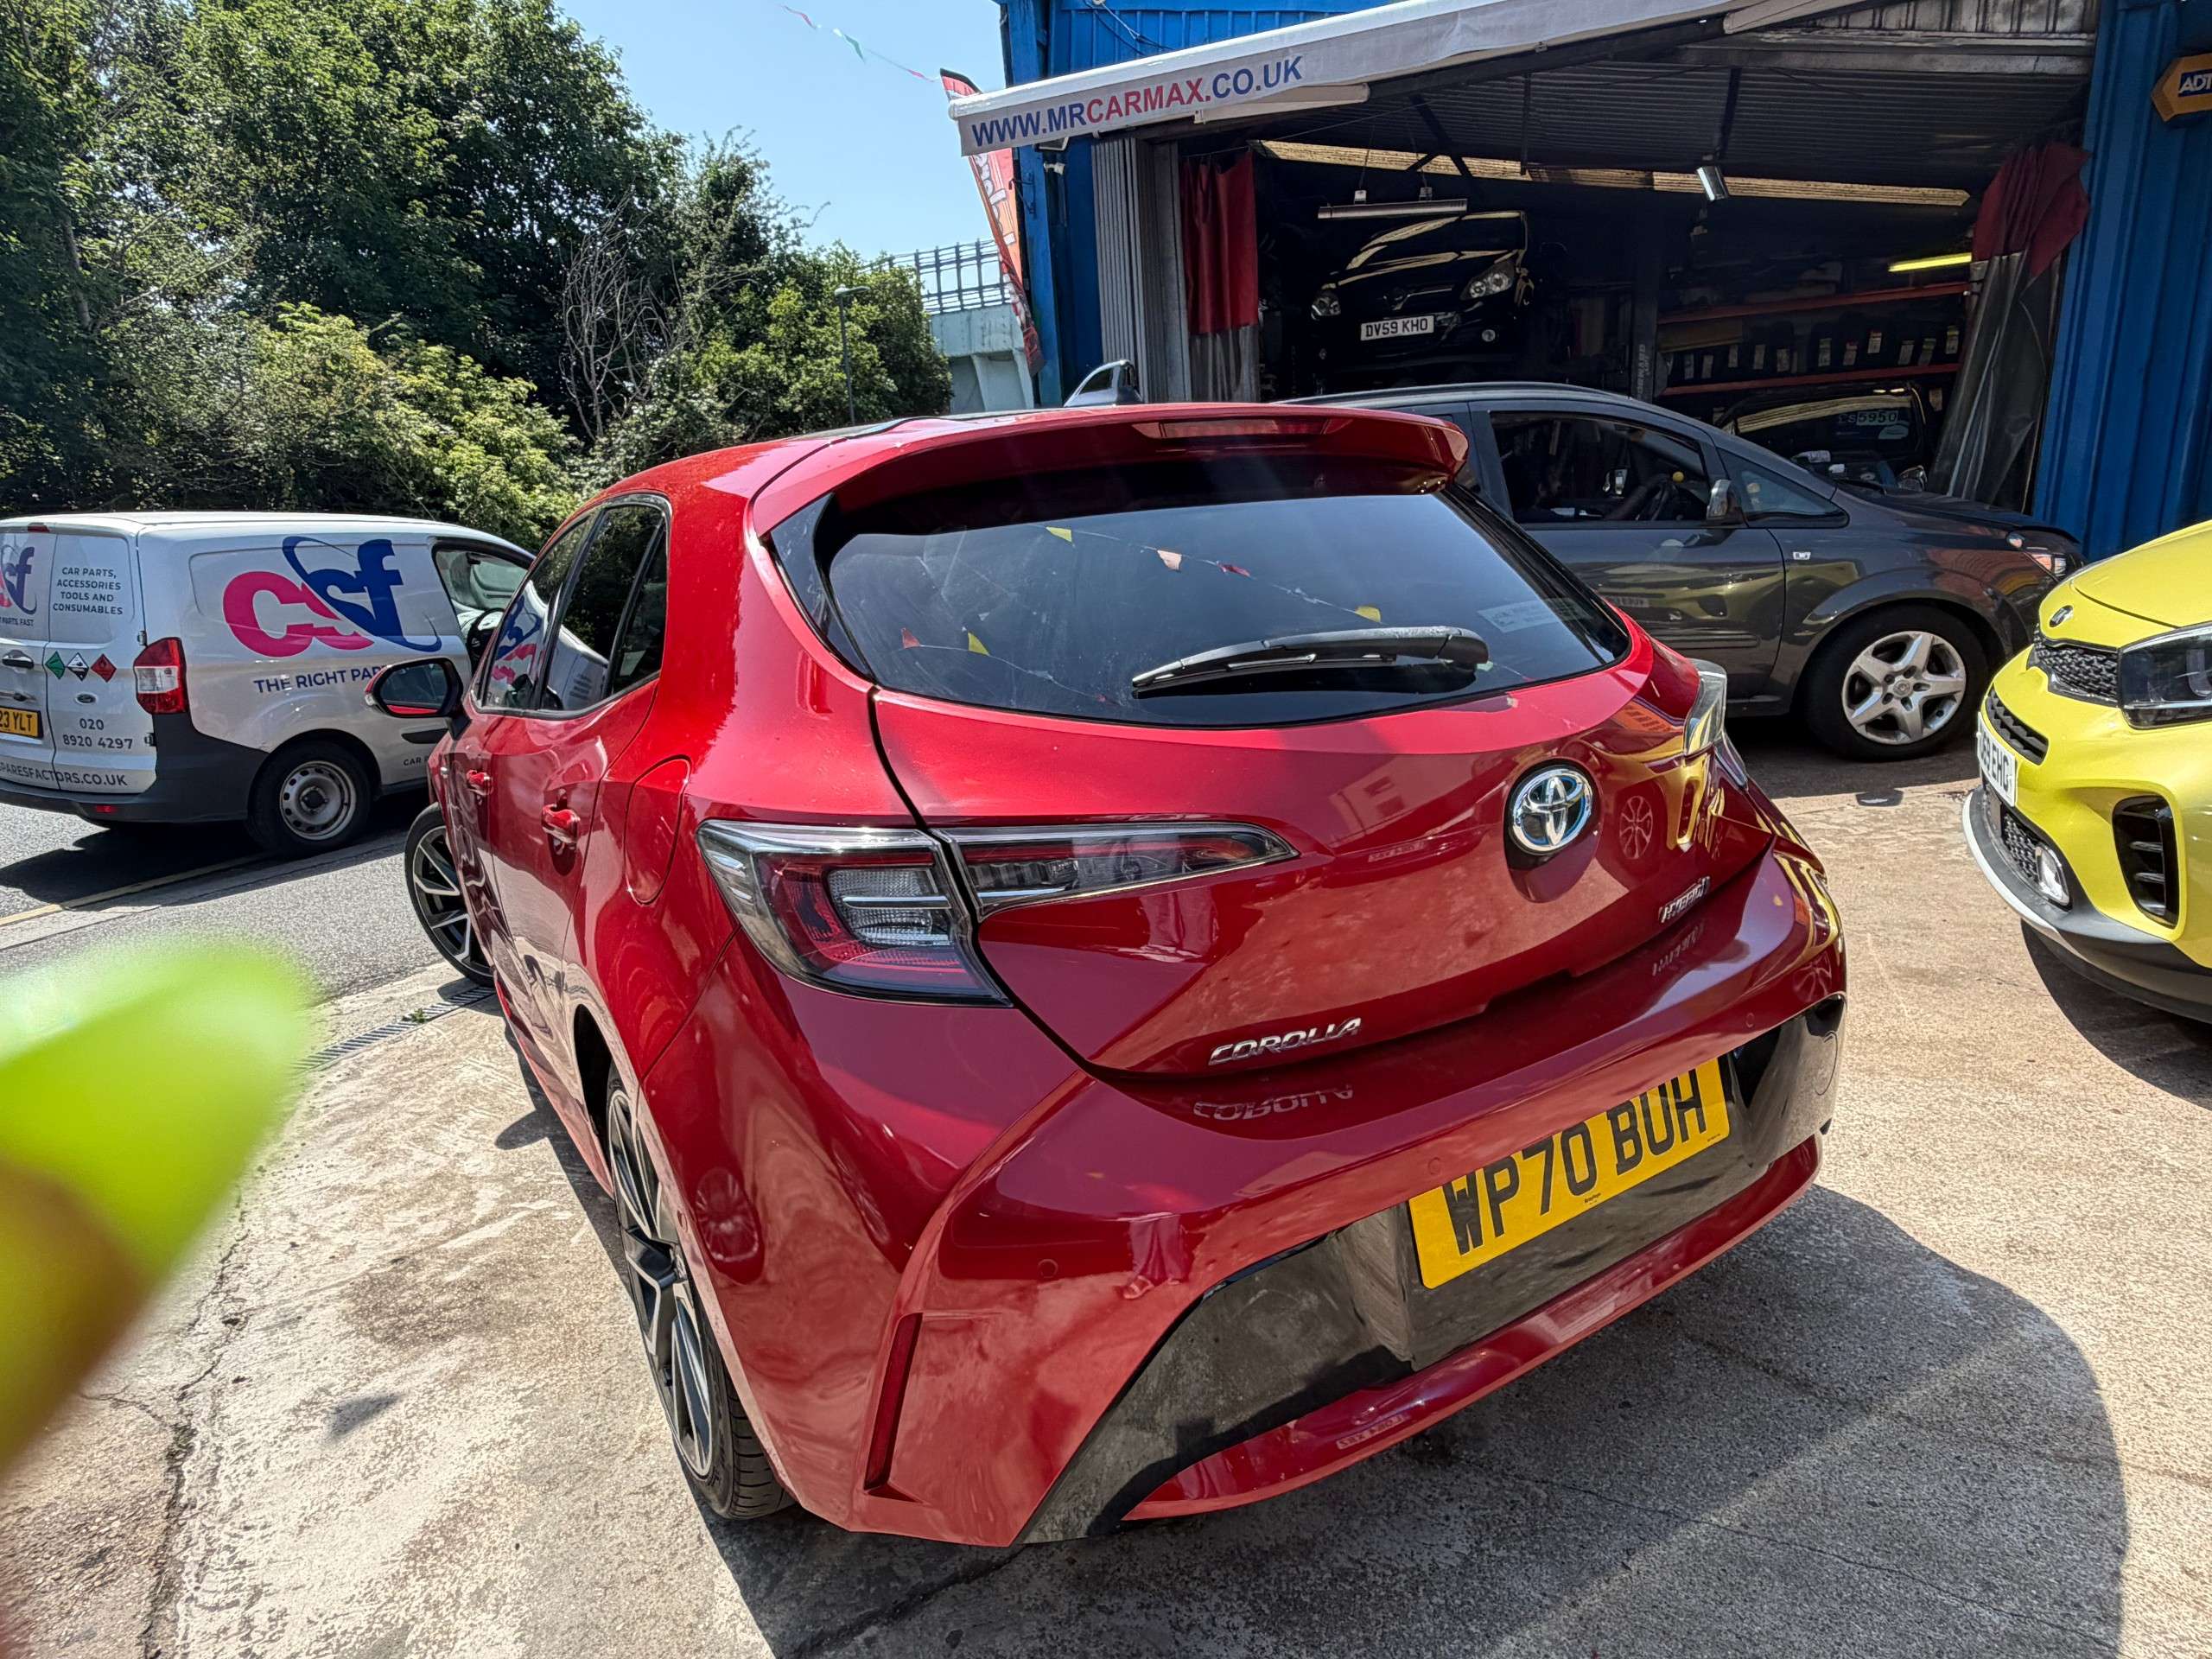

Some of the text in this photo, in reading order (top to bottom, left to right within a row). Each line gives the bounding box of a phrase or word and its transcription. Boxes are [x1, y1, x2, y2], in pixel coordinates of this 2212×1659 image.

[972, 55, 1303, 147] WWW.MRCARMAX.CO.UK
[1365, 321, 1398, 338] DV59
[61, 567, 117, 579] CAR PARTS,
[57, 579, 122, 590] ACCESSORIES
[60, 591, 114, 602] TOOLS AND
[53, 603, 124, 615] CONSUMABLES
[253, 664, 387, 693] THE RIGHT PAR
[13, 712, 33, 732] YLT
[79, 718, 105, 730] 020
[63, 734, 133, 749] 8920 4297
[404, 757, 422, 766] CAR
[0, 762, 128, 786] PARESFACTORS.CO.UK
[1208, 1016, 1362, 1066] COROLLA
[1442, 1068, 1707, 1256] WP70 BUH
